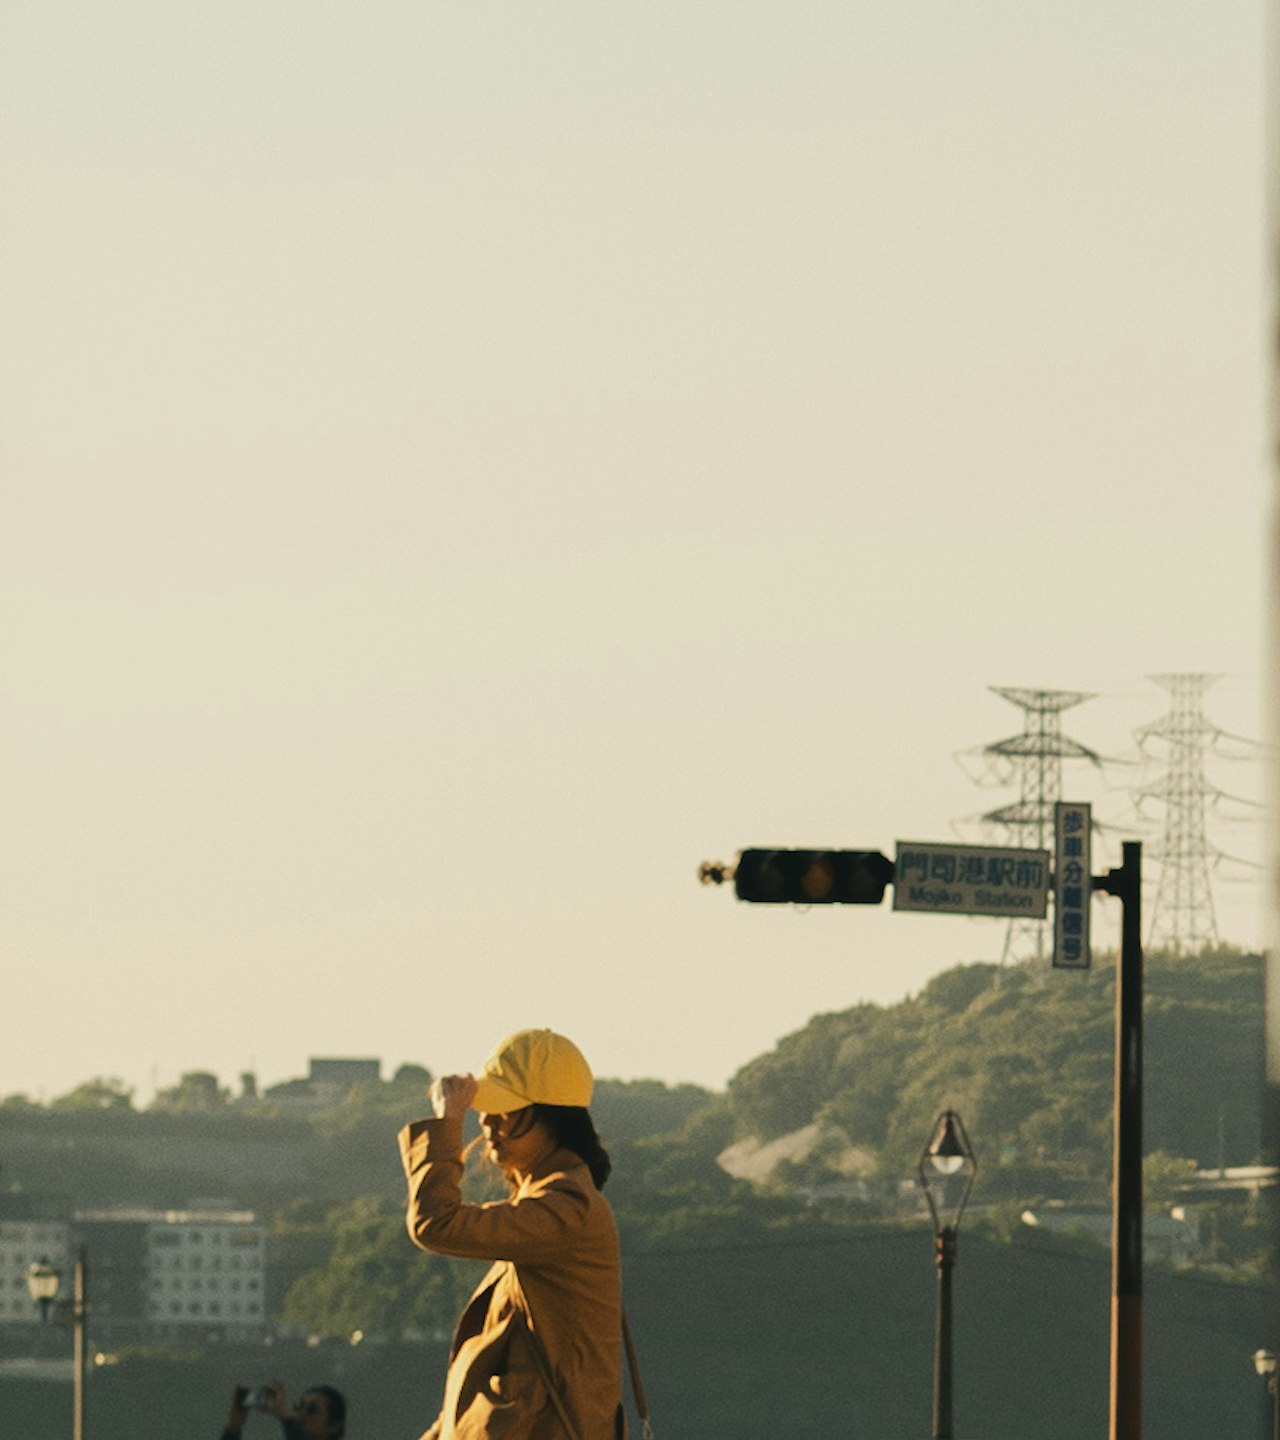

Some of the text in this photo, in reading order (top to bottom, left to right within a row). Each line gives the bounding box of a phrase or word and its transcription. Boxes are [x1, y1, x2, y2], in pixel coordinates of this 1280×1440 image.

[901, 852, 1043, 889] 門司港駅前
[909, 887, 1032, 908] Mojiko Station
